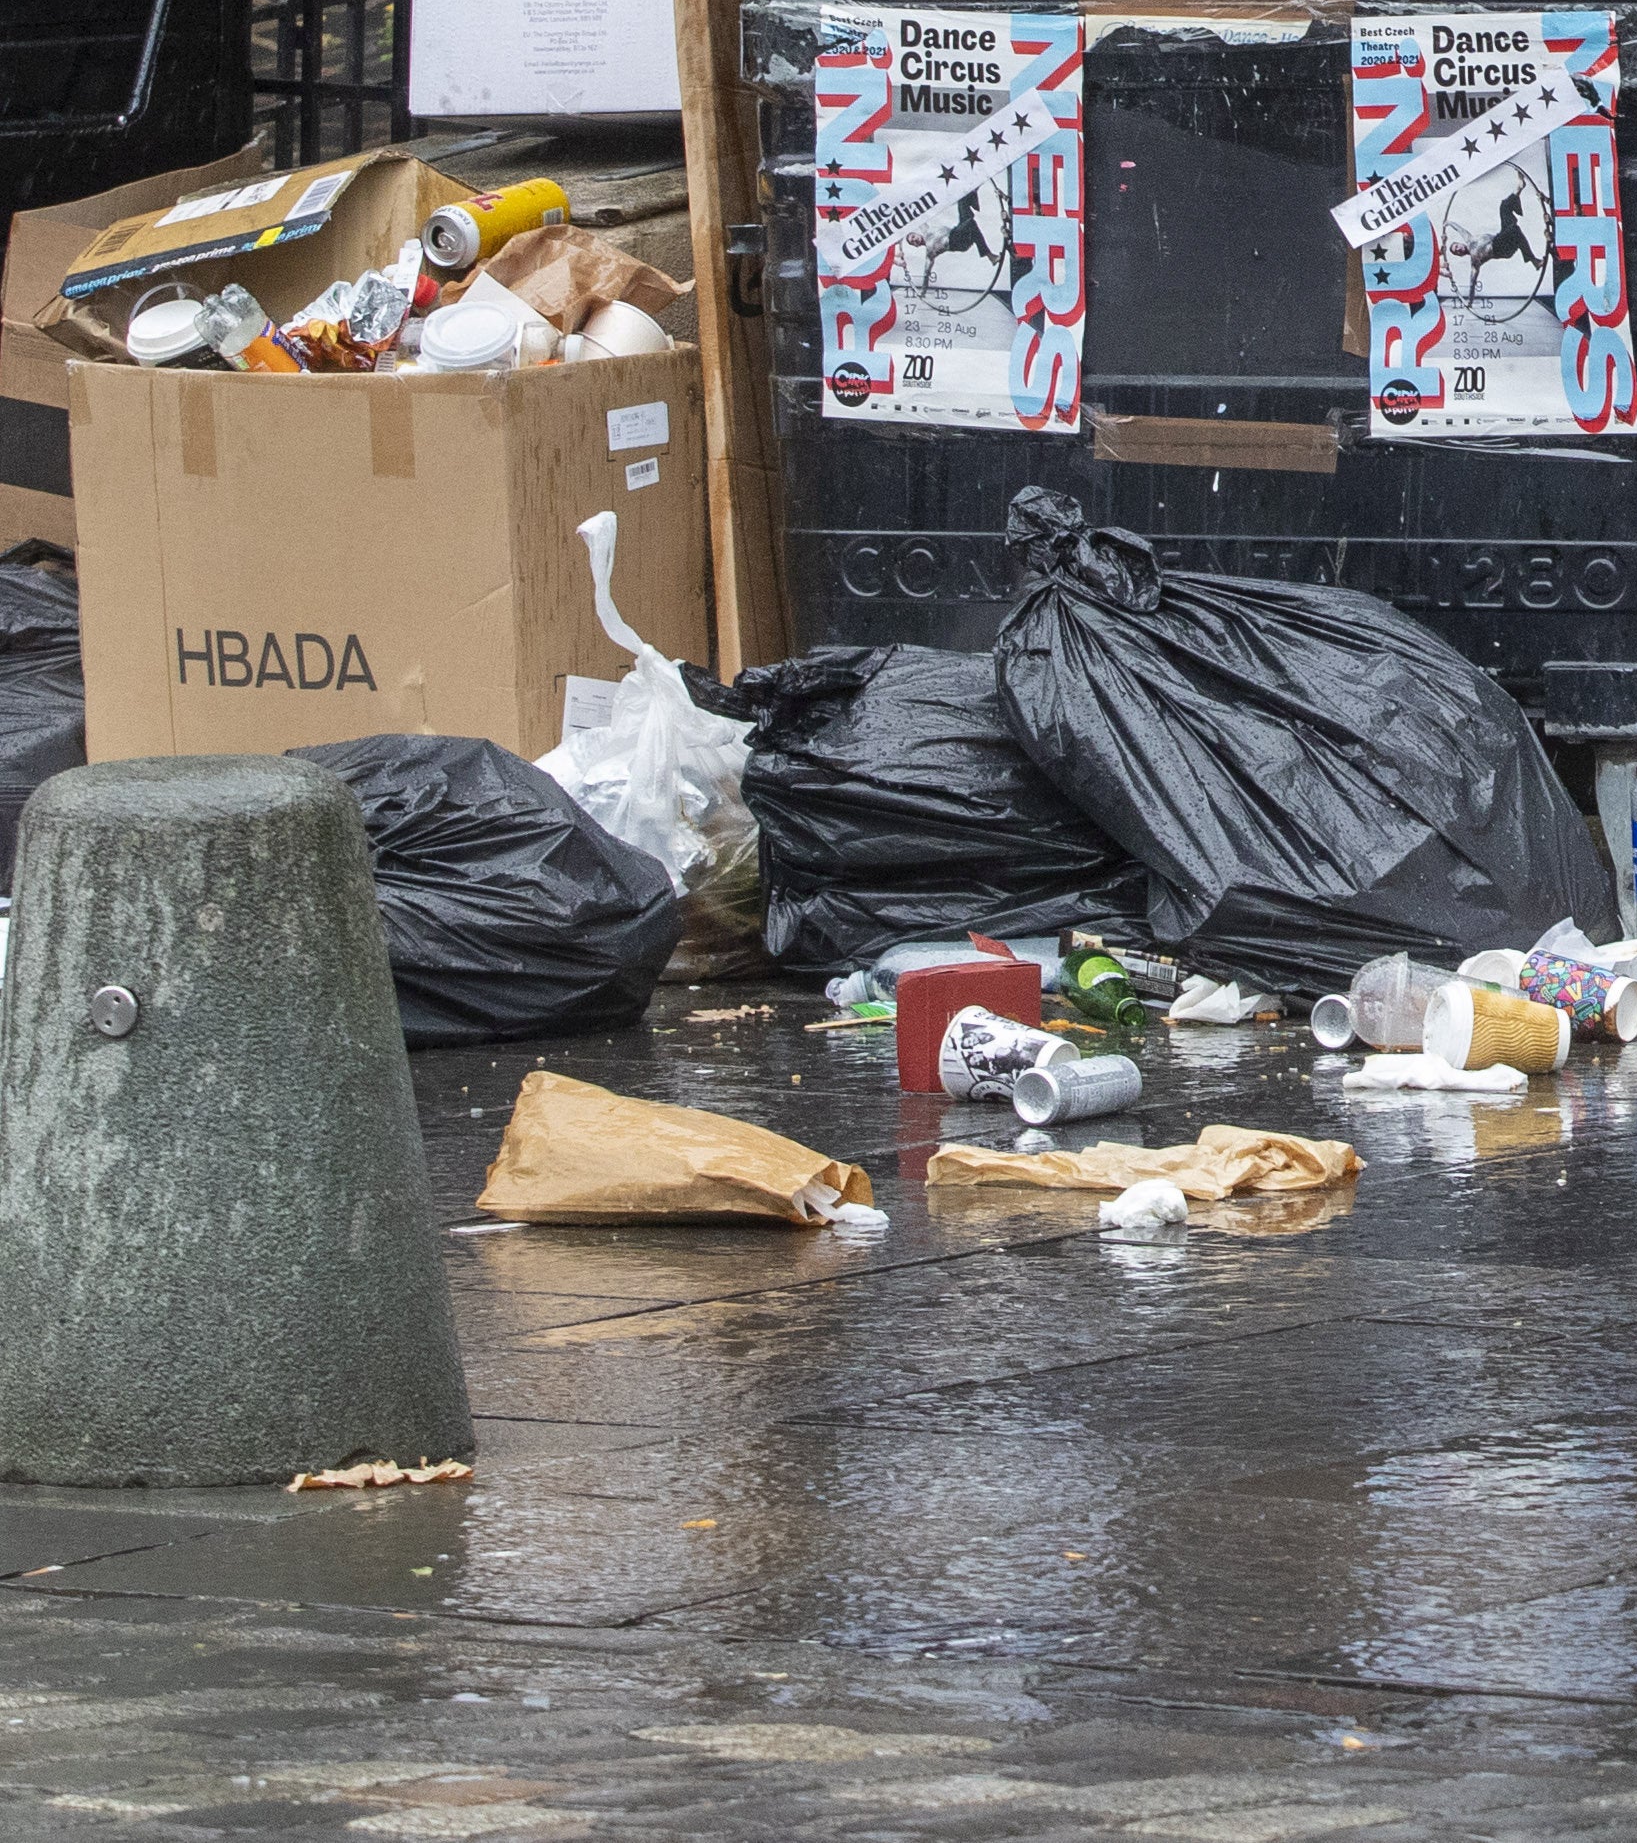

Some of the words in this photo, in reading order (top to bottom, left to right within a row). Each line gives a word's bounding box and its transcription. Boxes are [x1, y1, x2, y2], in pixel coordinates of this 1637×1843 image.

[900, 19, 996, 53] Dance
[1360, 27, 1383, 37] Best
[1384, 26, 1415, 38] Czech
[1360, 41, 1400, 52] Theatre
[1432, 24, 1530, 55] Dance
[900, 51, 1001, 85] Circus
[1360, 56, 1386, 66] 2020
[1396, 54, 1420, 66] 2021
[1433, 55, 1537, 88] Circus
[900, 83, 993, 116] Music
[1360, 163, 1461, 233] Guardian
[1370, 171, 1413, 207] The
[841, 191, 938, 261] Guardian
[849, 200, 892, 236] The
[904, 336, 931, 349] 8.30
[933, 338, 954, 350] PM
[954, 321, 977, 338] Aug
[1501, 331, 1524, 345] Aug
[903, 354, 934, 381] ZOO
[1453, 348, 1478, 360] 8.30
[1481, 348, 1501, 360] PM
[1453, 366, 1486, 393] ZOO
[1453, 392, 1486, 402] SOUTHSIDE
[1432, 546, 1632, 611] 1280
[176, 627, 378, 692] HBADA
